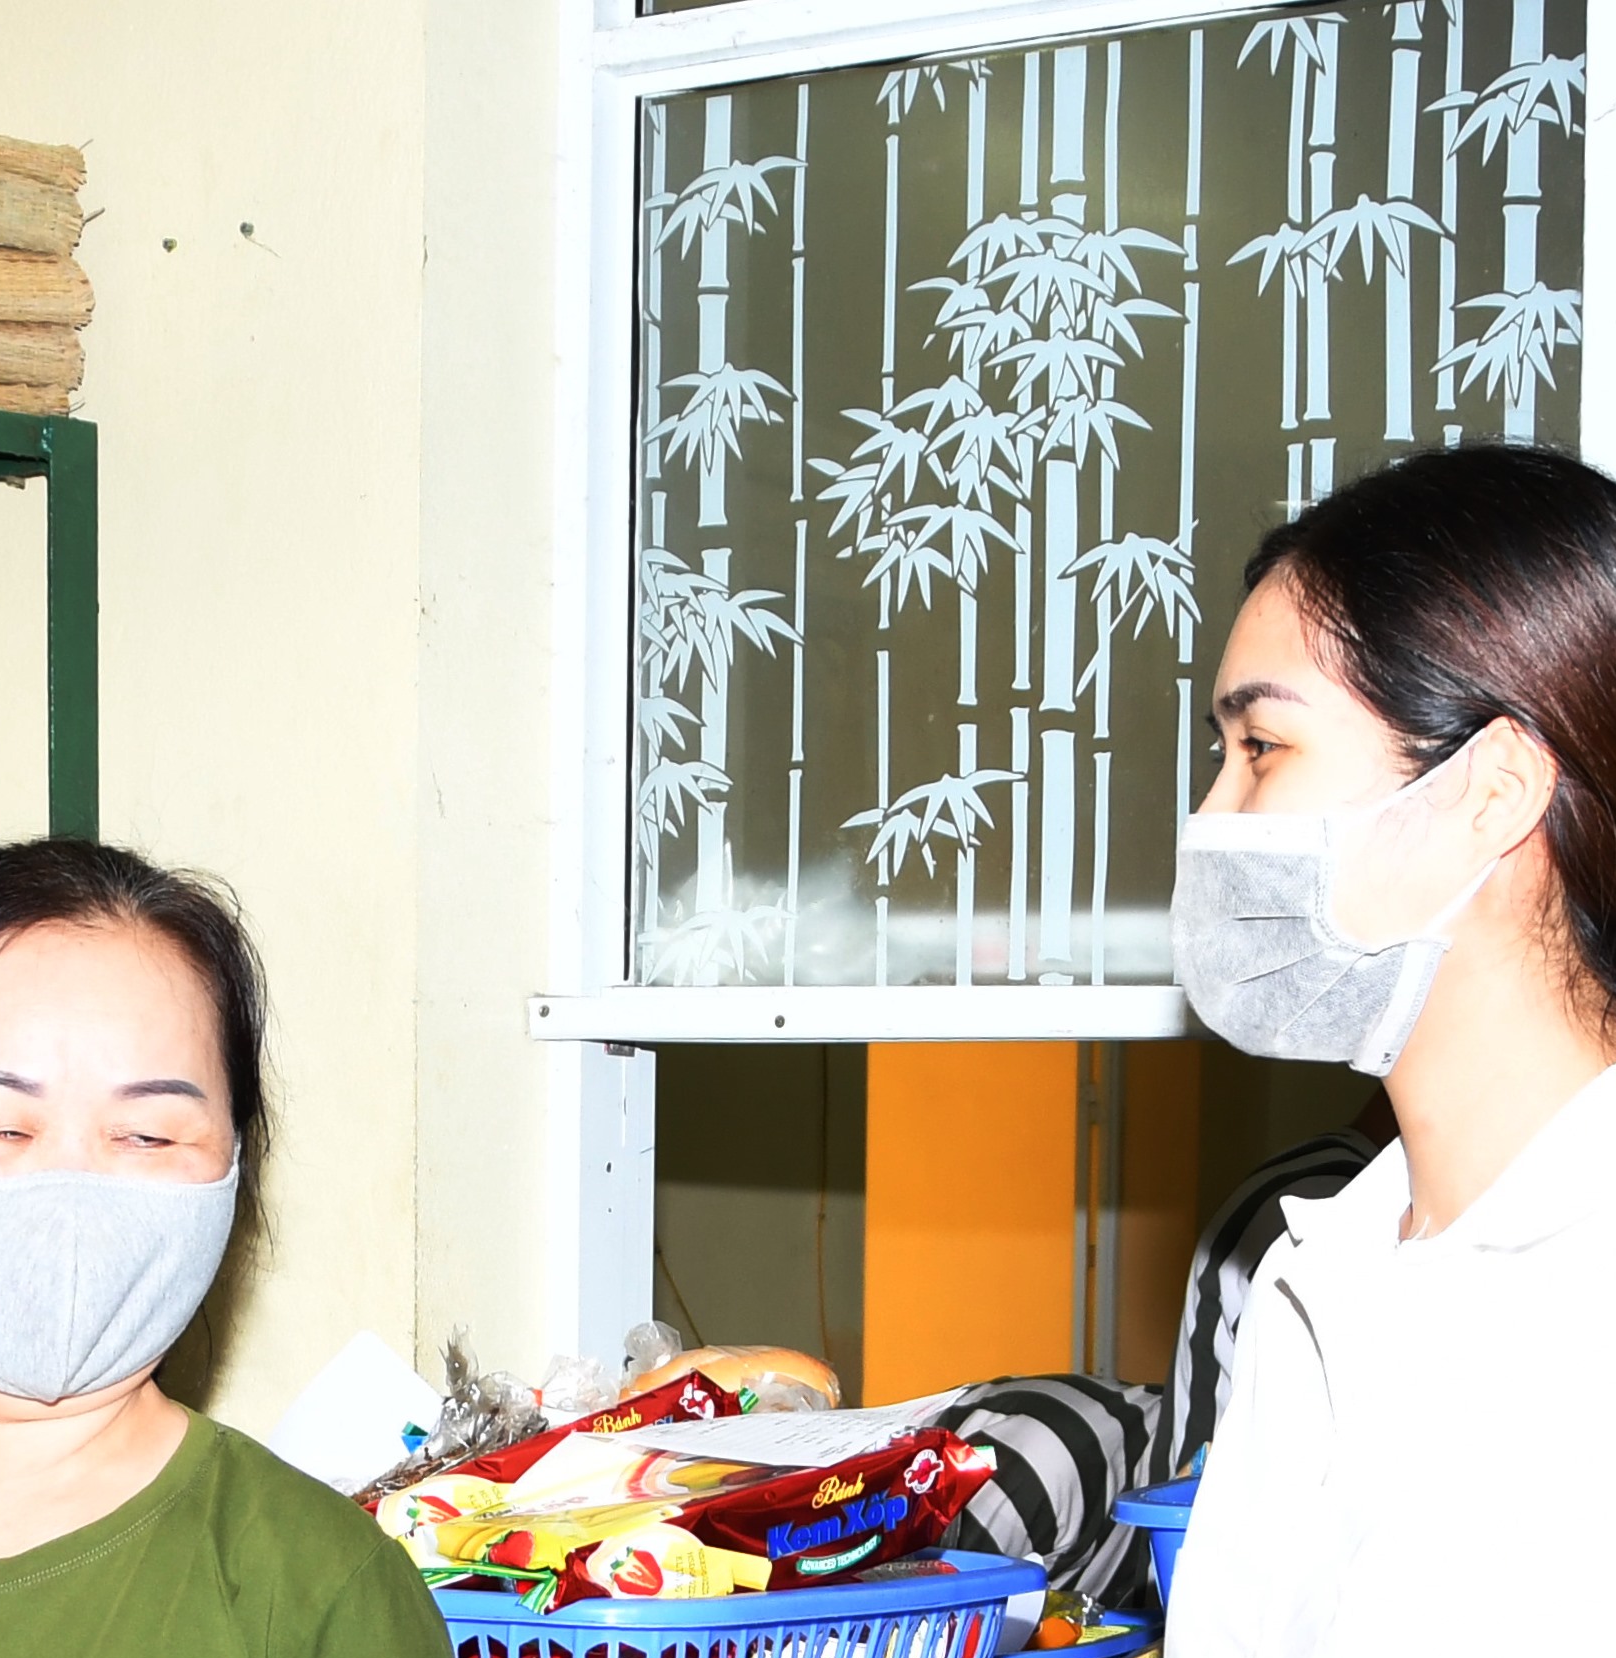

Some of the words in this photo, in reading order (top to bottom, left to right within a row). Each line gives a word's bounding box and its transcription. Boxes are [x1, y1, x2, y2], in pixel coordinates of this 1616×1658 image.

[811, 1472, 865, 1509] Bánh
[766, 1515, 841, 1560] Kem
[842, 1489, 908, 1535] Xốp
